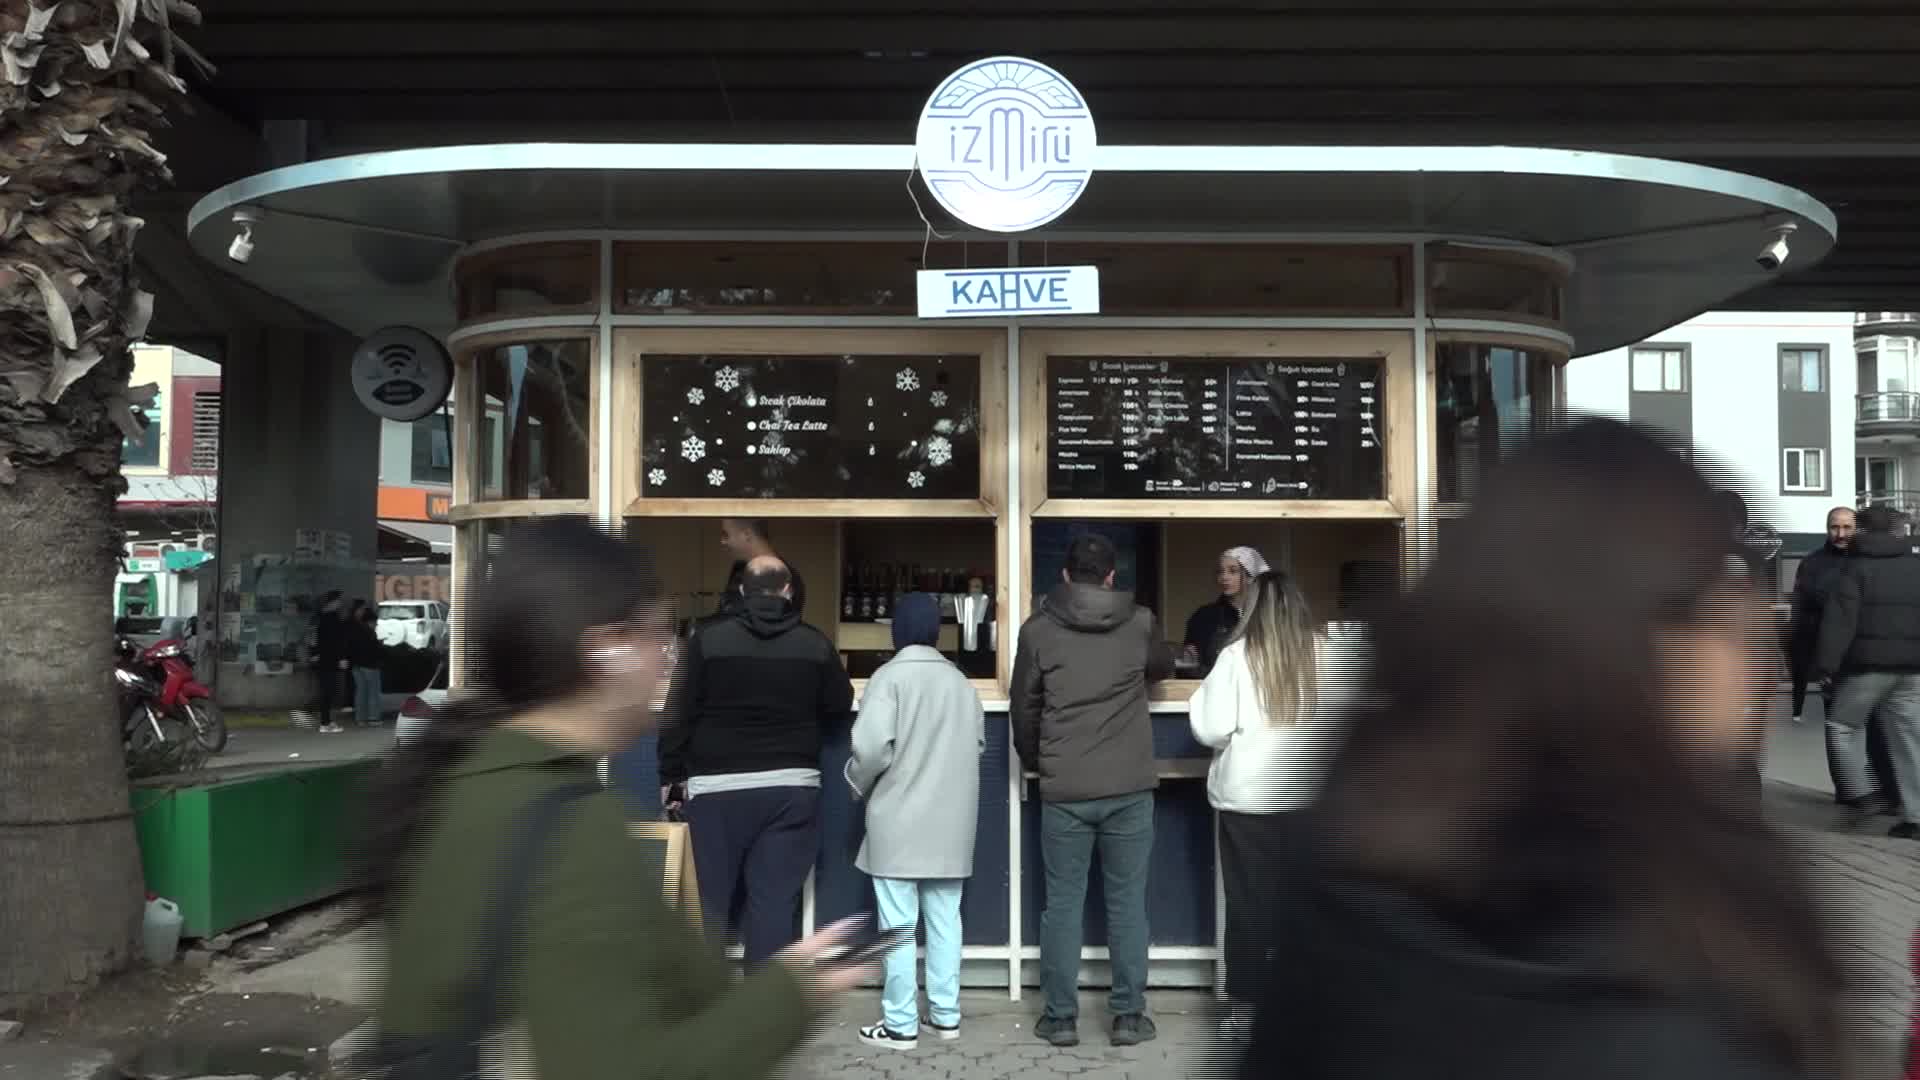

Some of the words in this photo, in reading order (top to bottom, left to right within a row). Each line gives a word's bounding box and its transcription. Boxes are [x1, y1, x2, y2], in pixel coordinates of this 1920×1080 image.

[952, 273, 1068, 309] KAHVE
[759, 394, 784, 406] Sıcak
[787, 395, 826, 408] Çikolata
[758, 420, 781, 430] Chai
[783, 420, 800, 431] Tea
[802, 420, 828, 430] Latte
